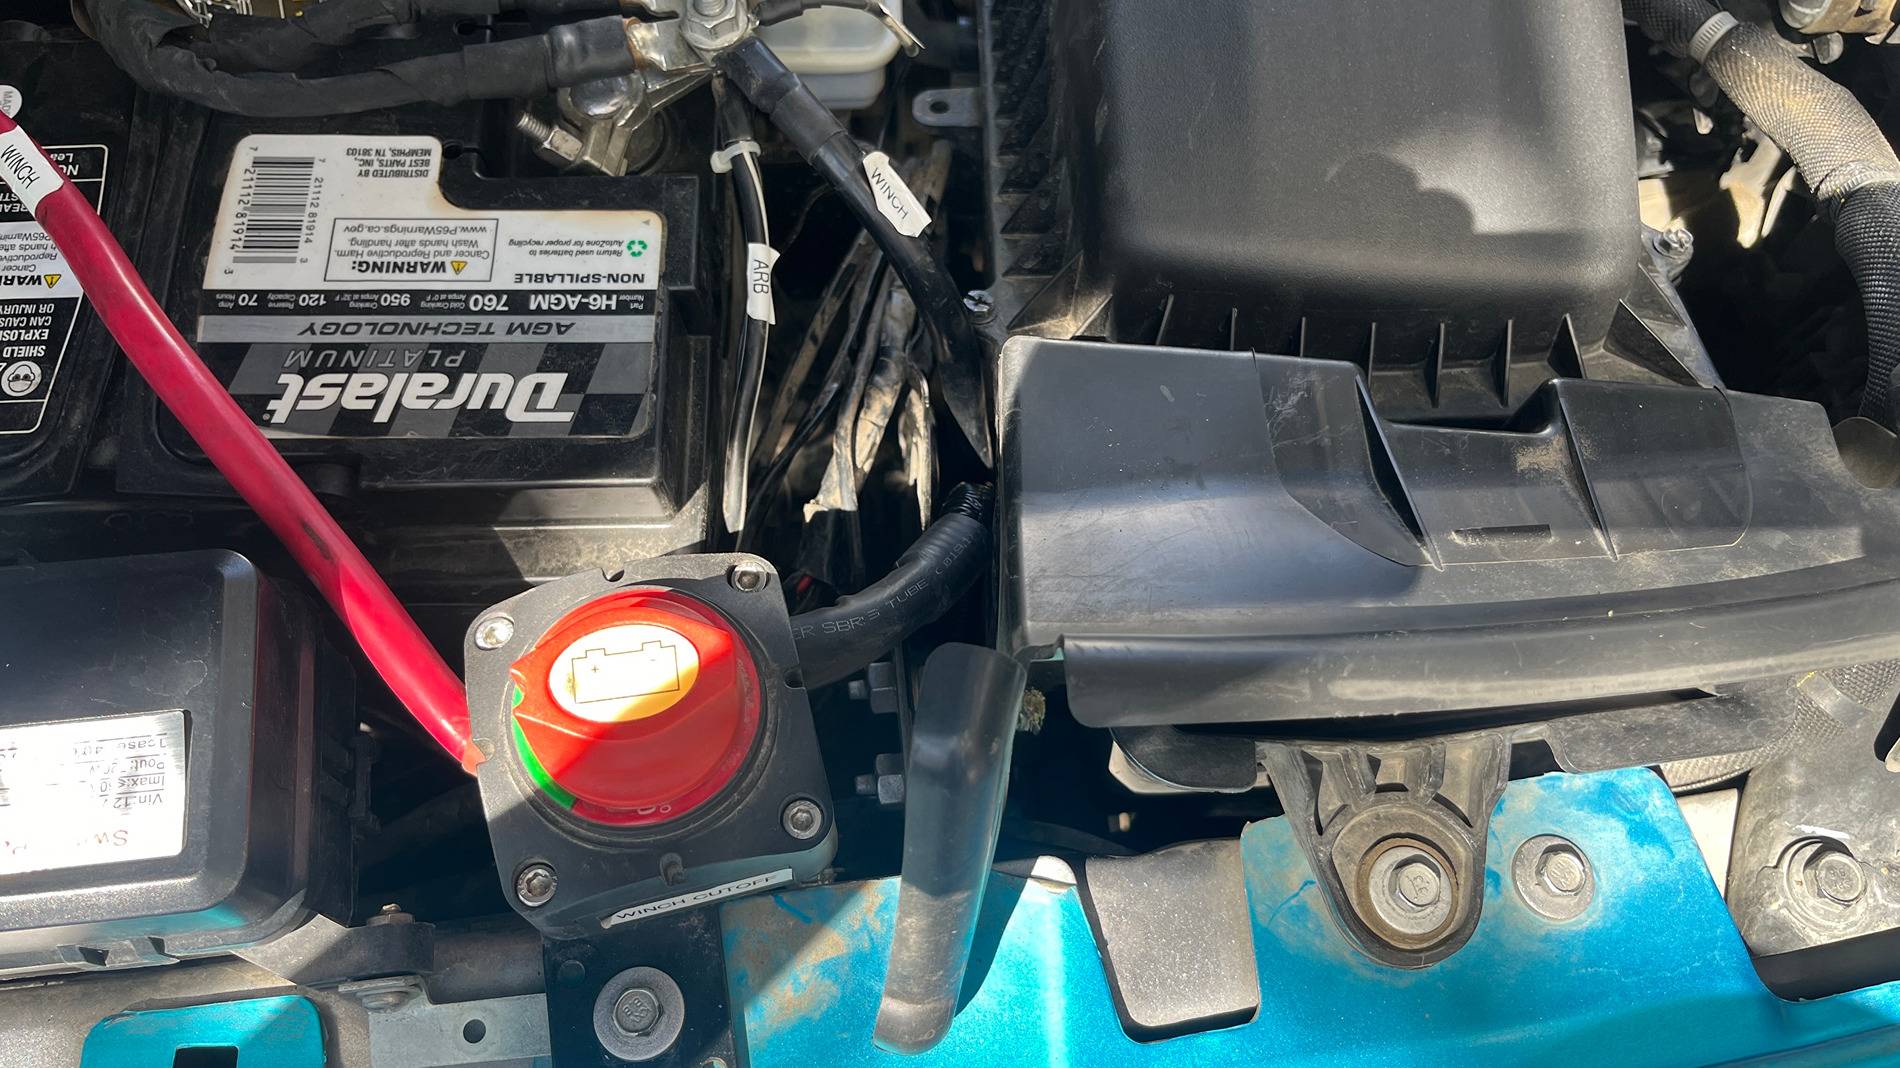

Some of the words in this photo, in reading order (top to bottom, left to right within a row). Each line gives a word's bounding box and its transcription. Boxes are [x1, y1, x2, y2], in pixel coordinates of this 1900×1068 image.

[345, 147, 373, 157] 38103
[374, 149, 387, 158] TN
[388, 148, 432, 158] MEMPHIS,
[1, 144, 40, 190] WINCH
[376, 158, 407, 168] PARTS,
[408, 159, 431, 168] BEST
[356, 168, 371, 179] BY
[371, 168, 429, 179] DISTRIBUTED
[870, 167, 909, 220] WINCH
[343, 223, 488, 236] www.P65Warnings.ca.gov
[18, 243, 49, 252] hands
[347, 237, 392, 249] handling.
[394, 239, 416, 249] after
[419, 239, 449, 249] hands
[451, 239, 480, 249] Wash
[508, 238, 544, 248] recycling
[545, 238, 572, 247] proper
[572, 240, 584, 248] for
[585, 240, 624, 249] AutoZone
[334, 249, 364, 259] Harm.
[366, 248, 430, 260] Reproductive
[433, 249, 449, 260] and
[455, 249, 490, 260] Cancer
[528, 249, 538, 257] to
[539, 249, 574, 258] batteries
[575, 249, 594, 258] used
[596, 249, 623, 258] Return
[2, 264, 37, 273] Cancer
[351, 260, 447, 274] WARNING:
[513, 273, 645, 284] NON-SPILLABLE
[753, 259, 770, 294] ARB
[215, 293, 236, 301] Hours
[237, 293, 259, 306] 70
[267, 292, 296, 301] Capacity
[298, 293, 328, 307] 120
[359, 292, 379, 301] Amps
[380, 293, 411, 307] 950
[448, 293, 467, 301] Amps
[218, 301, 235, 309] Amp
[349, 300, 378, 309] Cranking
[420, 300, 449, 309] Cranking
[450, 301, 466, 309] Cold
[469, 294, 509, 311] 760
[529, 294, 618, 311] H6-AGM
[630, 302, 644, 310] Part
[38, 303, 55, 314] OR
[29, 316, 52, 327] CAN
[297, 322, 496, 336] TECHNOLOGY
[504, 322, 577, 336] AGM
[2, 345, 47, 358] SHIELD
[283, 350, 466, 368] PLATINUM
[266, 372, 575, 424] Duralast
[616, 898, 687, 919] WINCH
[693, 875, 778, 901] CUTOFF
